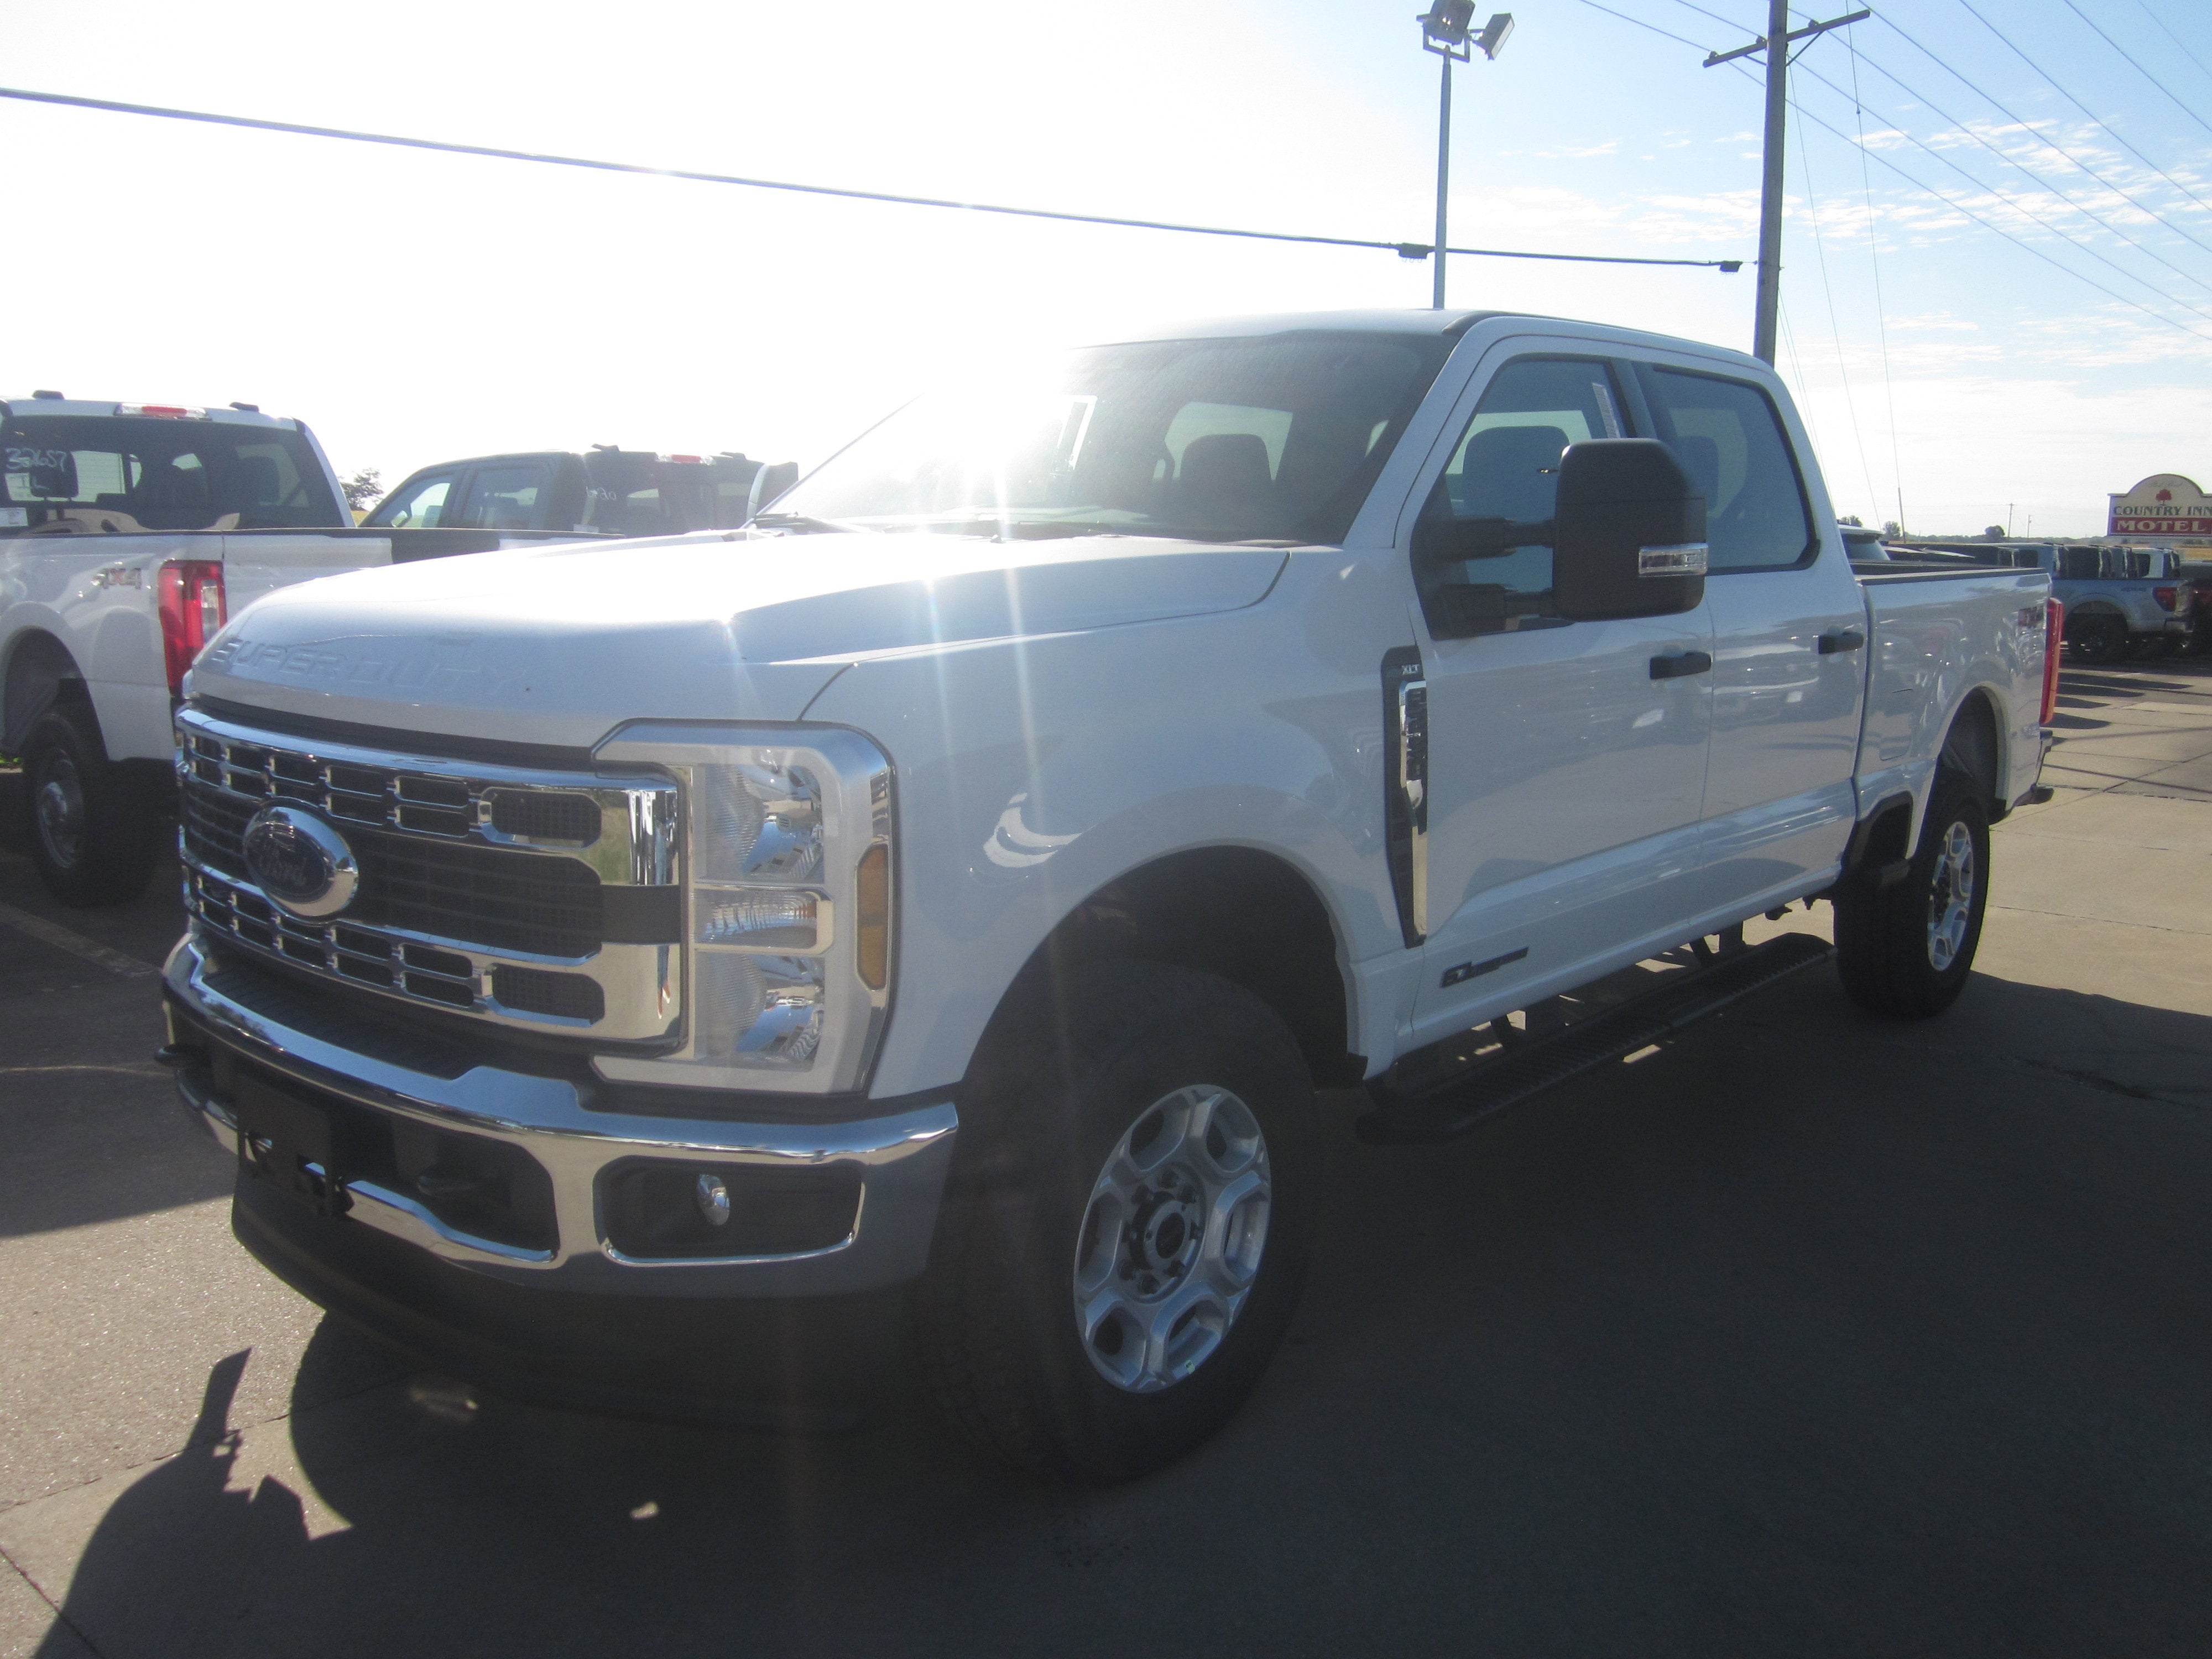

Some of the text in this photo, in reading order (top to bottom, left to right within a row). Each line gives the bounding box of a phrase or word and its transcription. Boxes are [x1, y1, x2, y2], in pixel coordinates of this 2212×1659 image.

[2114, 505, 2212, 516] COUNTRY INN
[2117, 520, 2206, 531] MOTEL
[1401, 664, 1420, 676] XLT
